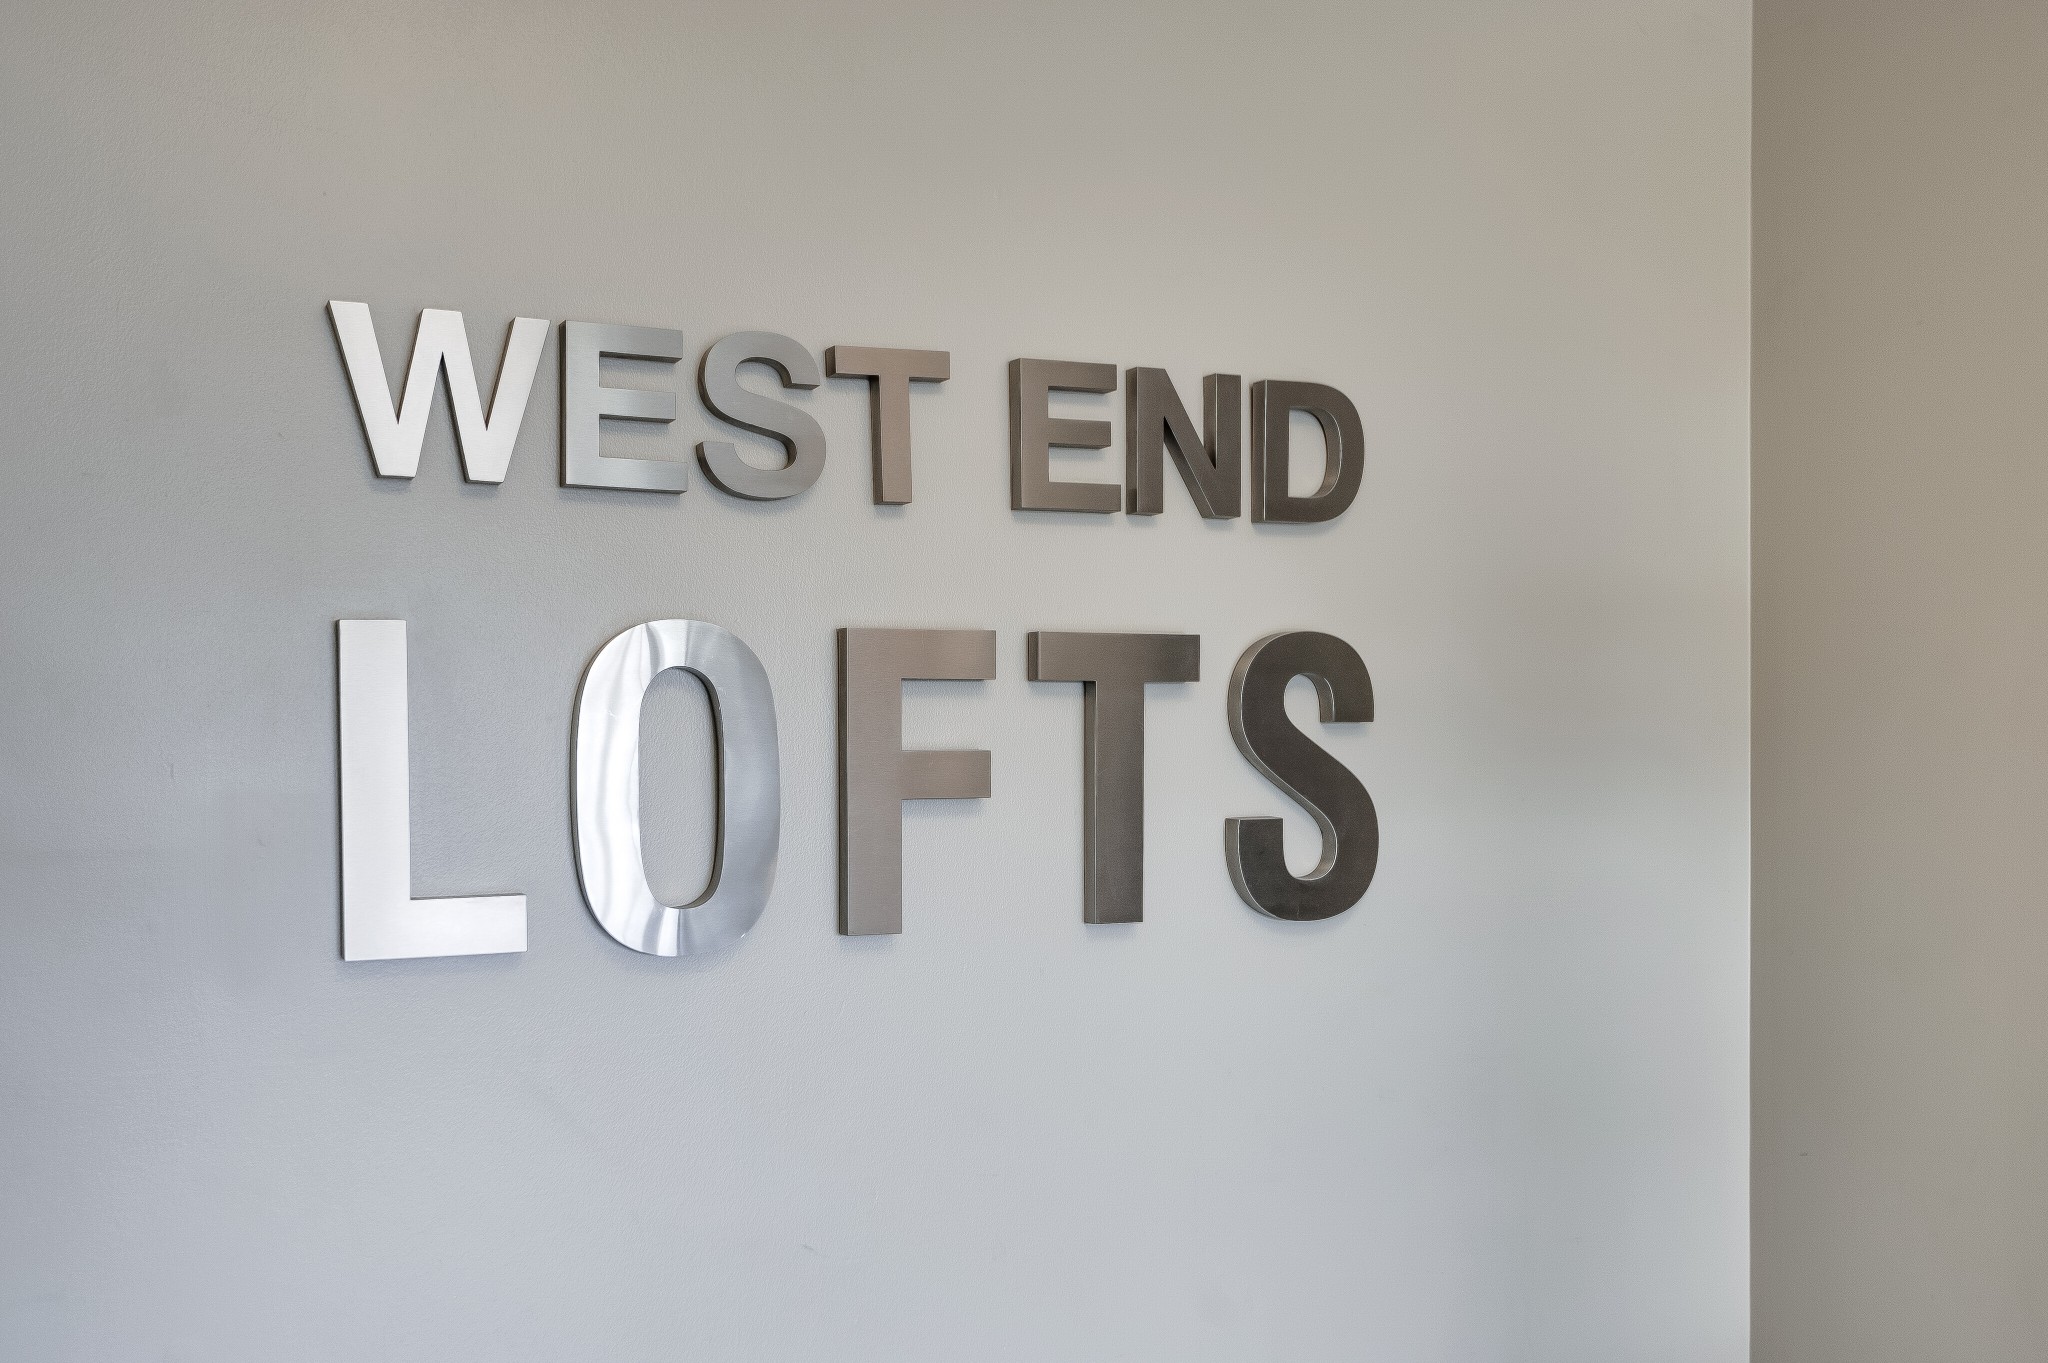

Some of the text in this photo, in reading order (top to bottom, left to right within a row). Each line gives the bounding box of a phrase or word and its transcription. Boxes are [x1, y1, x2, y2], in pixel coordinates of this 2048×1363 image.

[326, 300, 1366, 525] WEST END
[336, 618, 1380, 962] LOFTS
